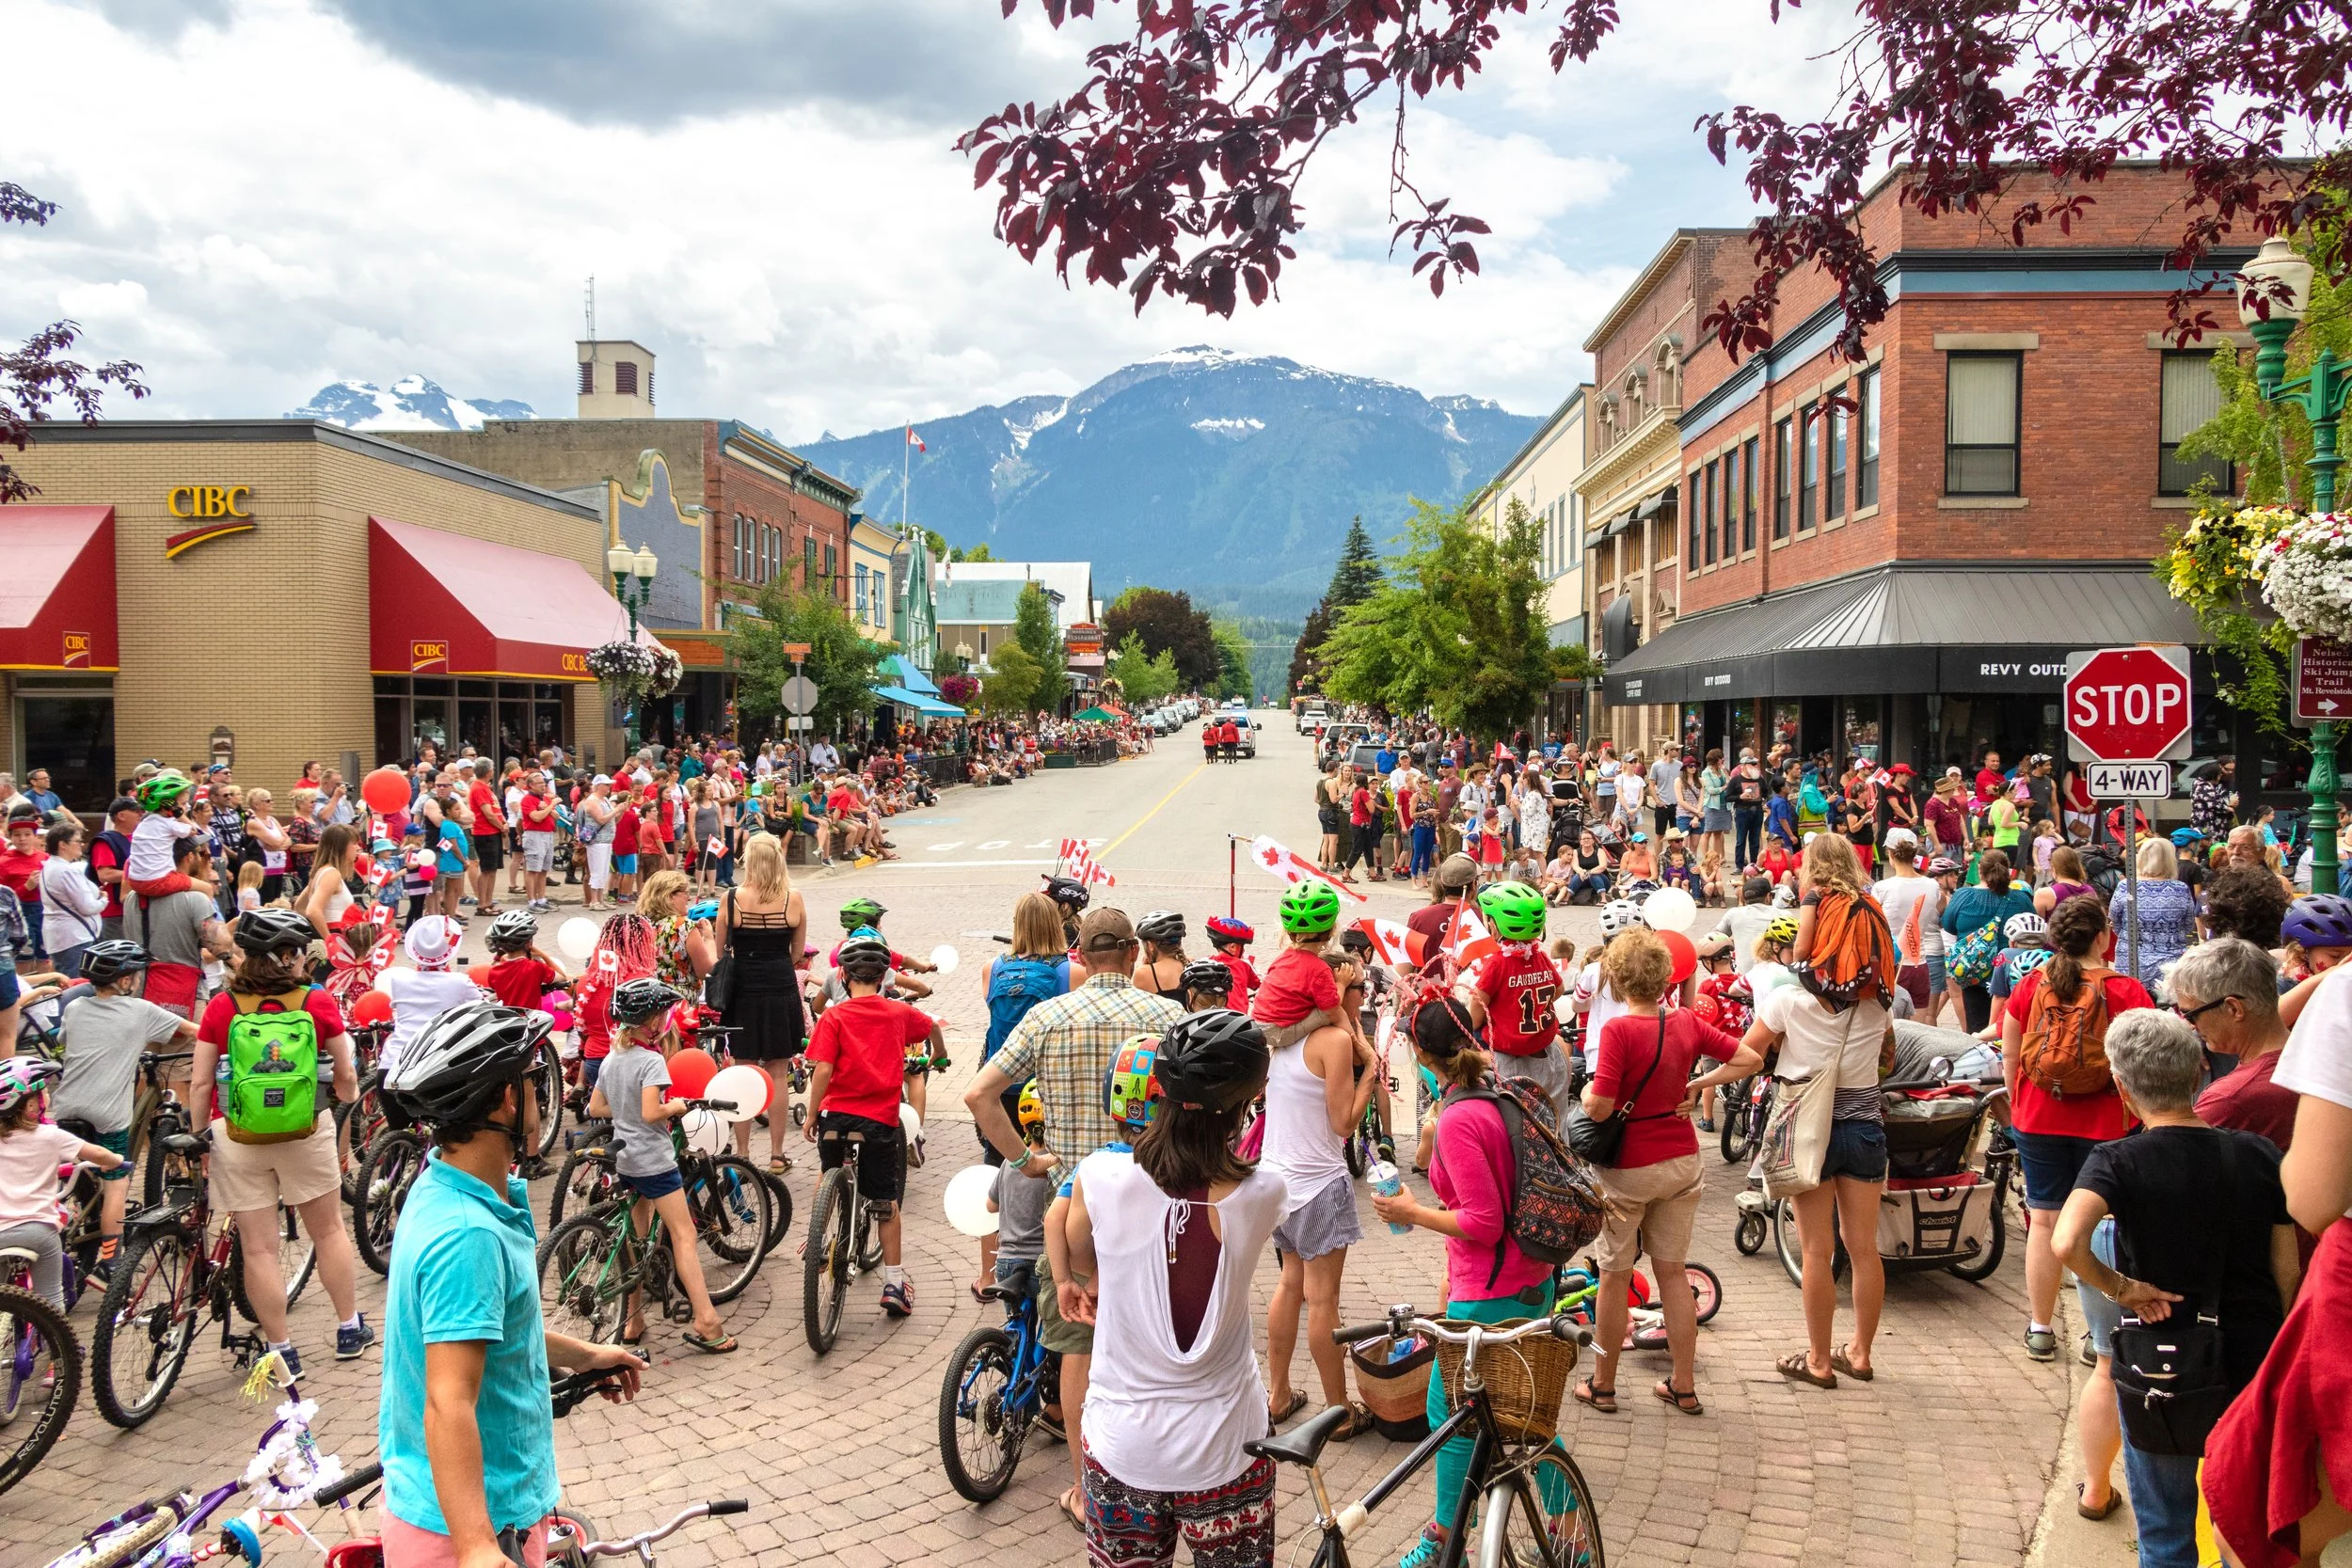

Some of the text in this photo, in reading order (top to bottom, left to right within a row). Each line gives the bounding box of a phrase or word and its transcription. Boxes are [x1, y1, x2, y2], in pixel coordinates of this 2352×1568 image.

[167, 484, 250, 517] CIBC
[65, 636, 88, 650] CIBC
[414, 643, 445, 657] CIBC
[562, 653, 579, 671] CIBC
[1980, 663, 2021, 675] REVY
[2074, 683, 2182, 727] STOP
[2095, 769, 2163, 791] 4-WAY
[1518, 984, 1556, 1034] 13
[17, 1378, 65, 1460] REVOLUTION
